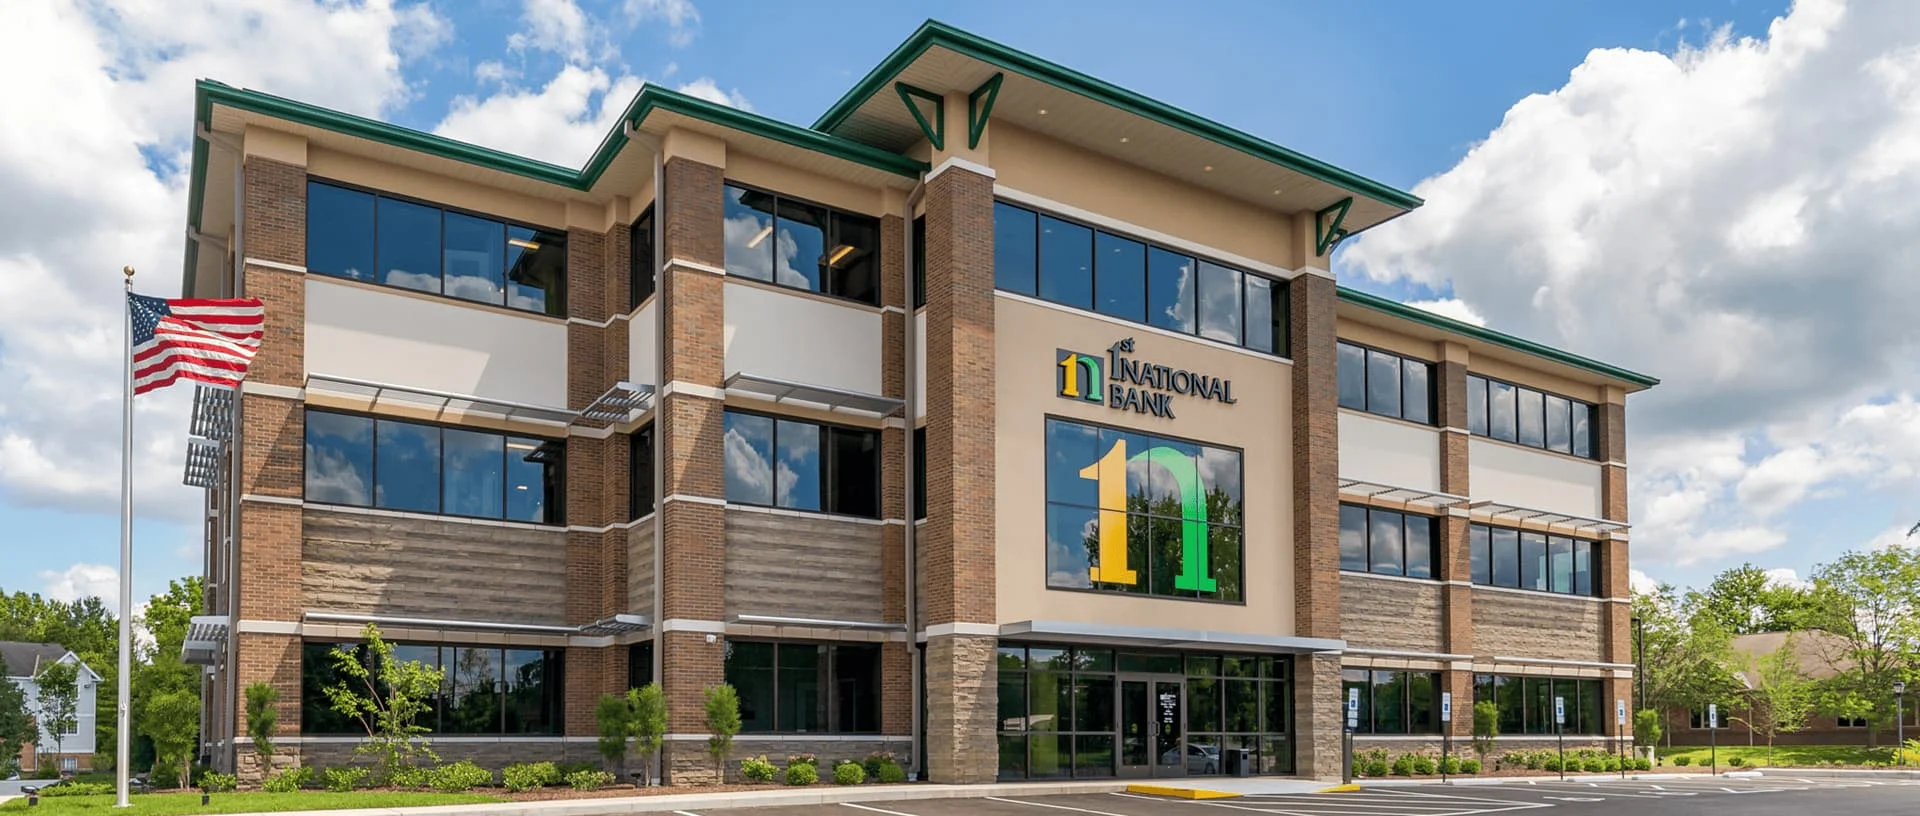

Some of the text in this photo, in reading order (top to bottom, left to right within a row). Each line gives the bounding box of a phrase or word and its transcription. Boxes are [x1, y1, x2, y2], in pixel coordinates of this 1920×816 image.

[1106, 337, 1238, 404] 1st NATIONAL
[1109, 383, 1176, 419] BANK
